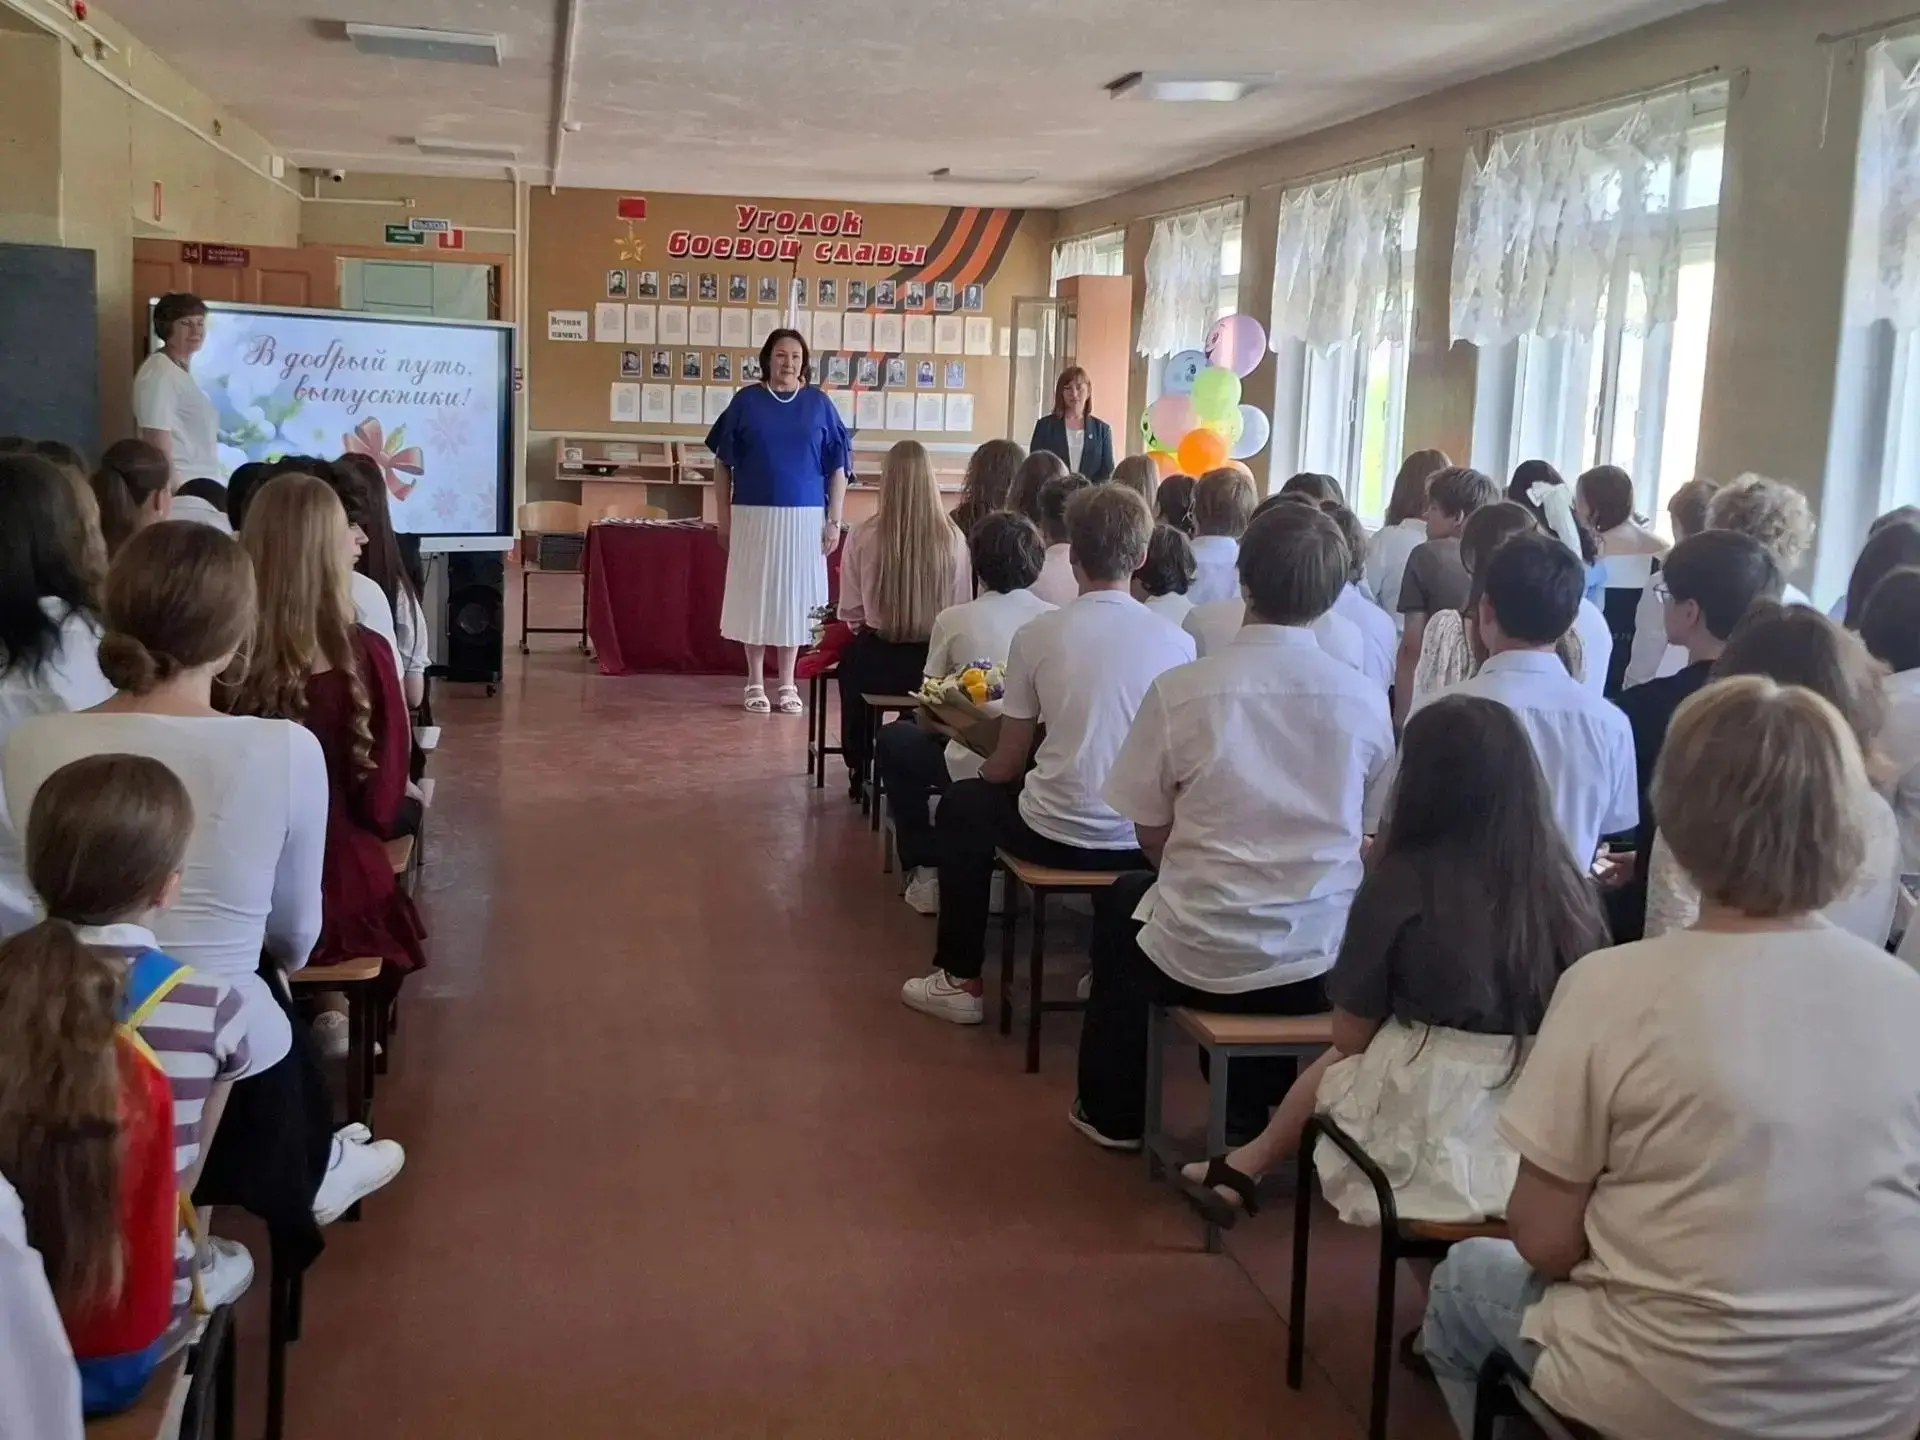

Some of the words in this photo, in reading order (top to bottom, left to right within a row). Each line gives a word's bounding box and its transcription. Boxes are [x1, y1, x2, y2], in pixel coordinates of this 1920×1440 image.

[735, 204, 863, 237] Уголок
[667, 229, 801, 261] боевой
[814, 238, 928, 267] славы
[243, 334, 276, 368] В
[280, 338, 387, 382] добрый
[293, 374, 471, 415] выпускники!
